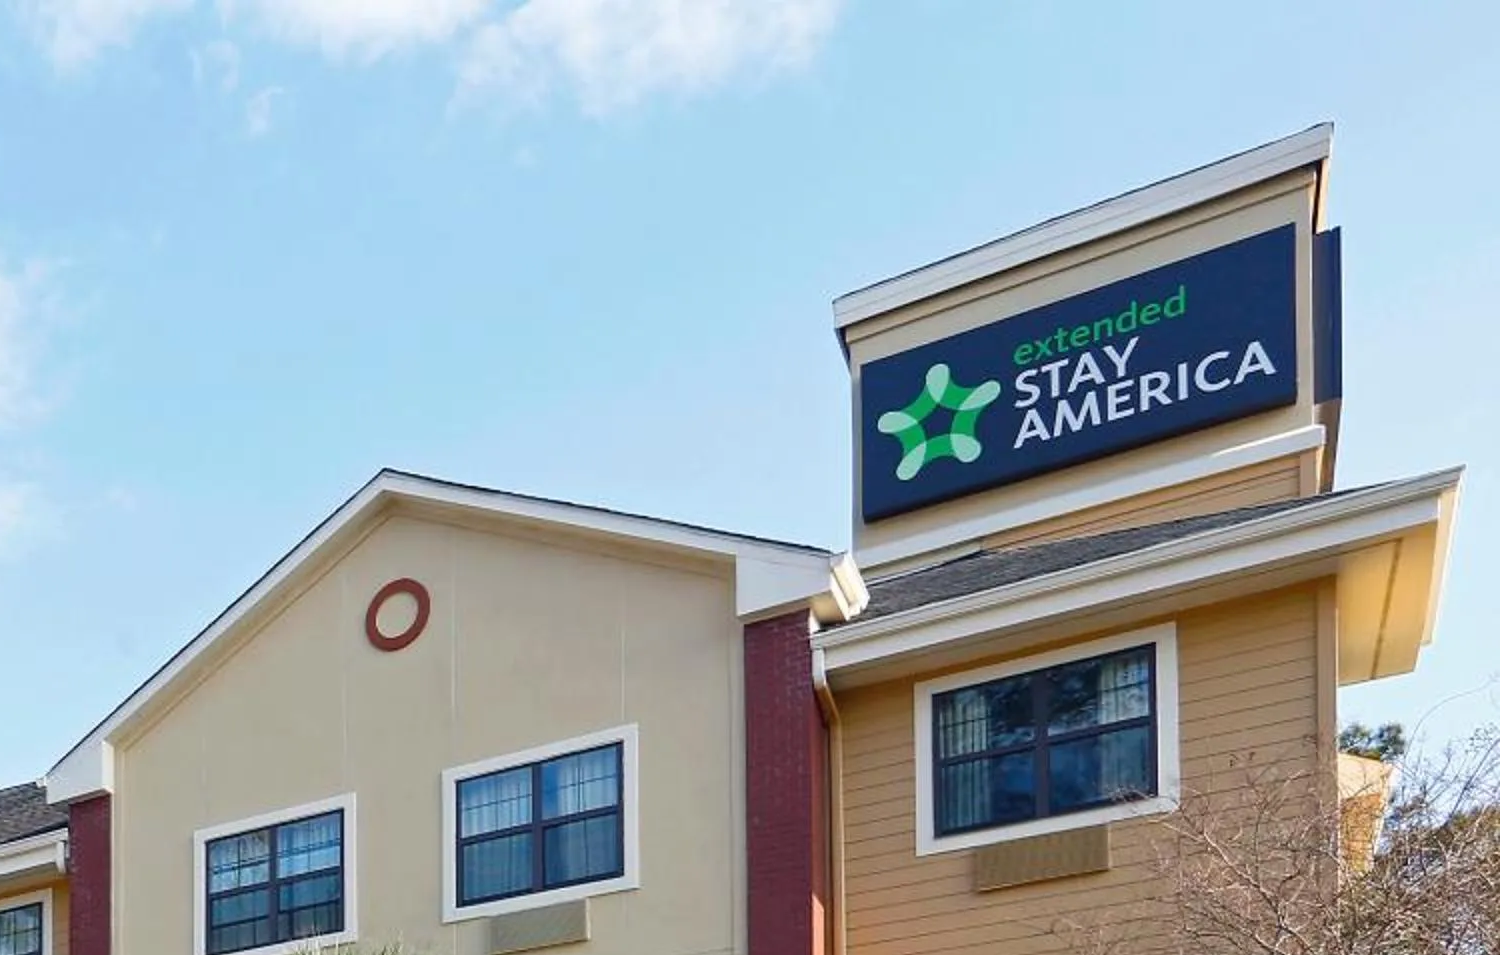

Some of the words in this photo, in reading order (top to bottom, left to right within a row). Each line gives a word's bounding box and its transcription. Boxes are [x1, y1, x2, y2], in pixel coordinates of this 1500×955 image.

[1012, 284, 1187, 366] extended
[1013, 336, 1140, 408] STAY
[1013, 341, 1277, 449] AMERICA
